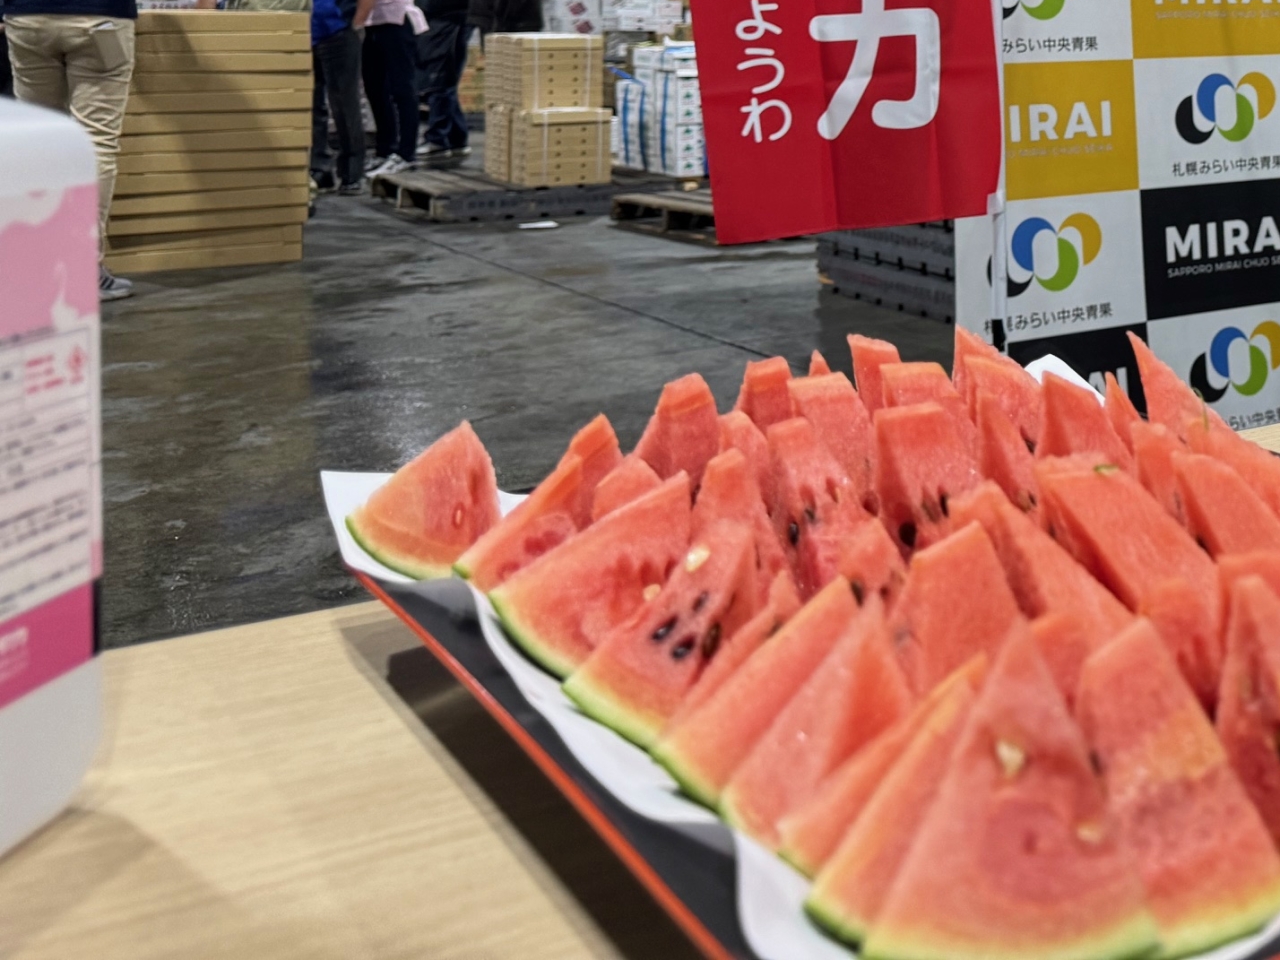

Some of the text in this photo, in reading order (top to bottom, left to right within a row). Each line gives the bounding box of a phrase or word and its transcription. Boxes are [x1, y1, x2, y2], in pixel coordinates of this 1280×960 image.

[1002, 36, 1098, 54] みらい中央青果
[1009, 100, 1113, 143] IRAI
[1167, 262, 1213, 279] SAPPORO
[1214, 259, 1242, 272] MIRAI
[1243, 256, 1269, 269] CHUO
